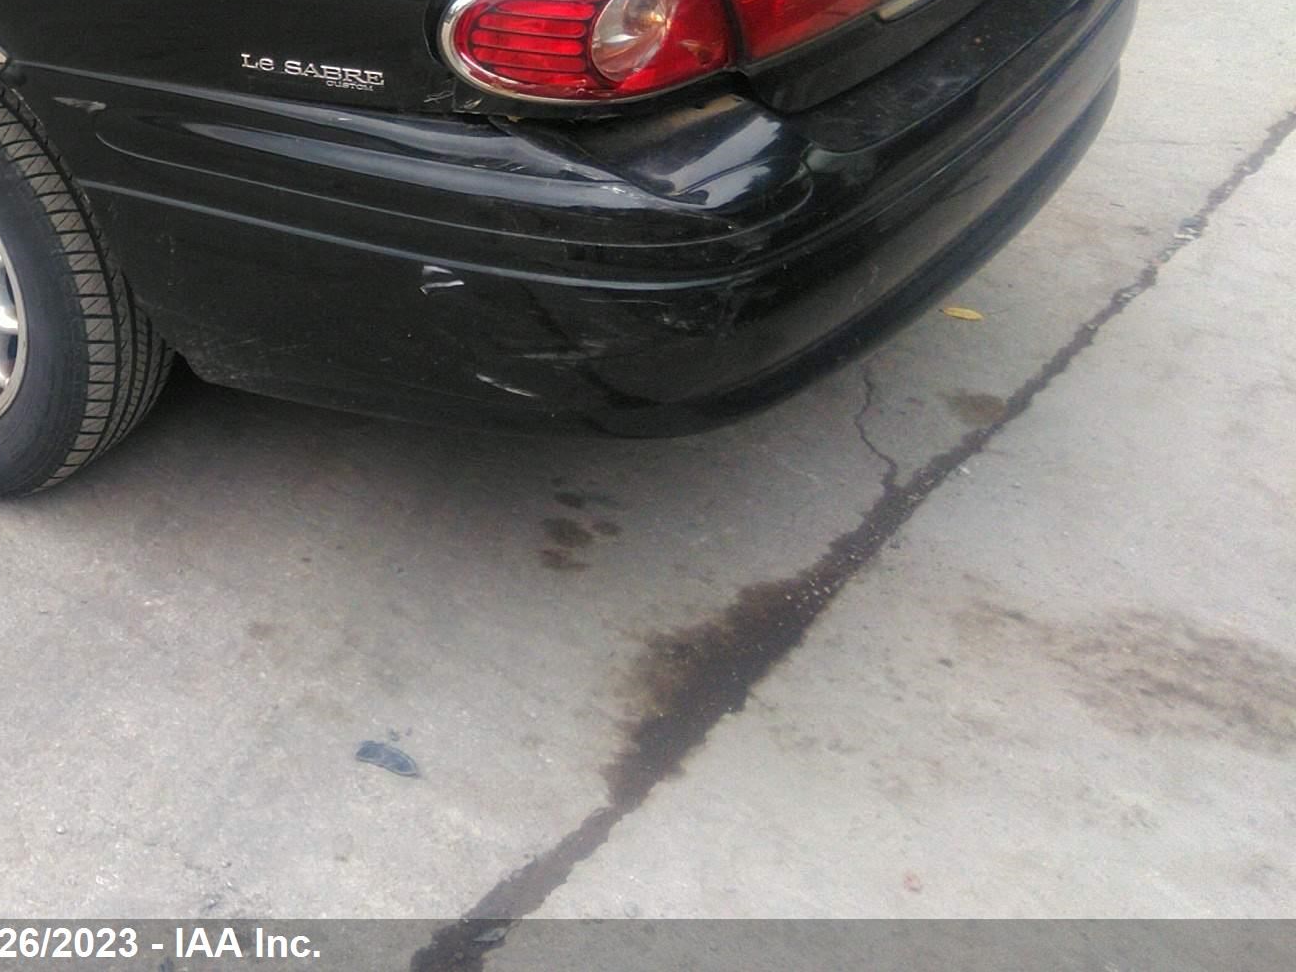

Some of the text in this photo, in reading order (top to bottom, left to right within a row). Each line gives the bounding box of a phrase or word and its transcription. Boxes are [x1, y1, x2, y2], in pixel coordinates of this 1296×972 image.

[241, 53, 385, 86] Le SABRE
[326, 80, 374, 91] CUSTOM
